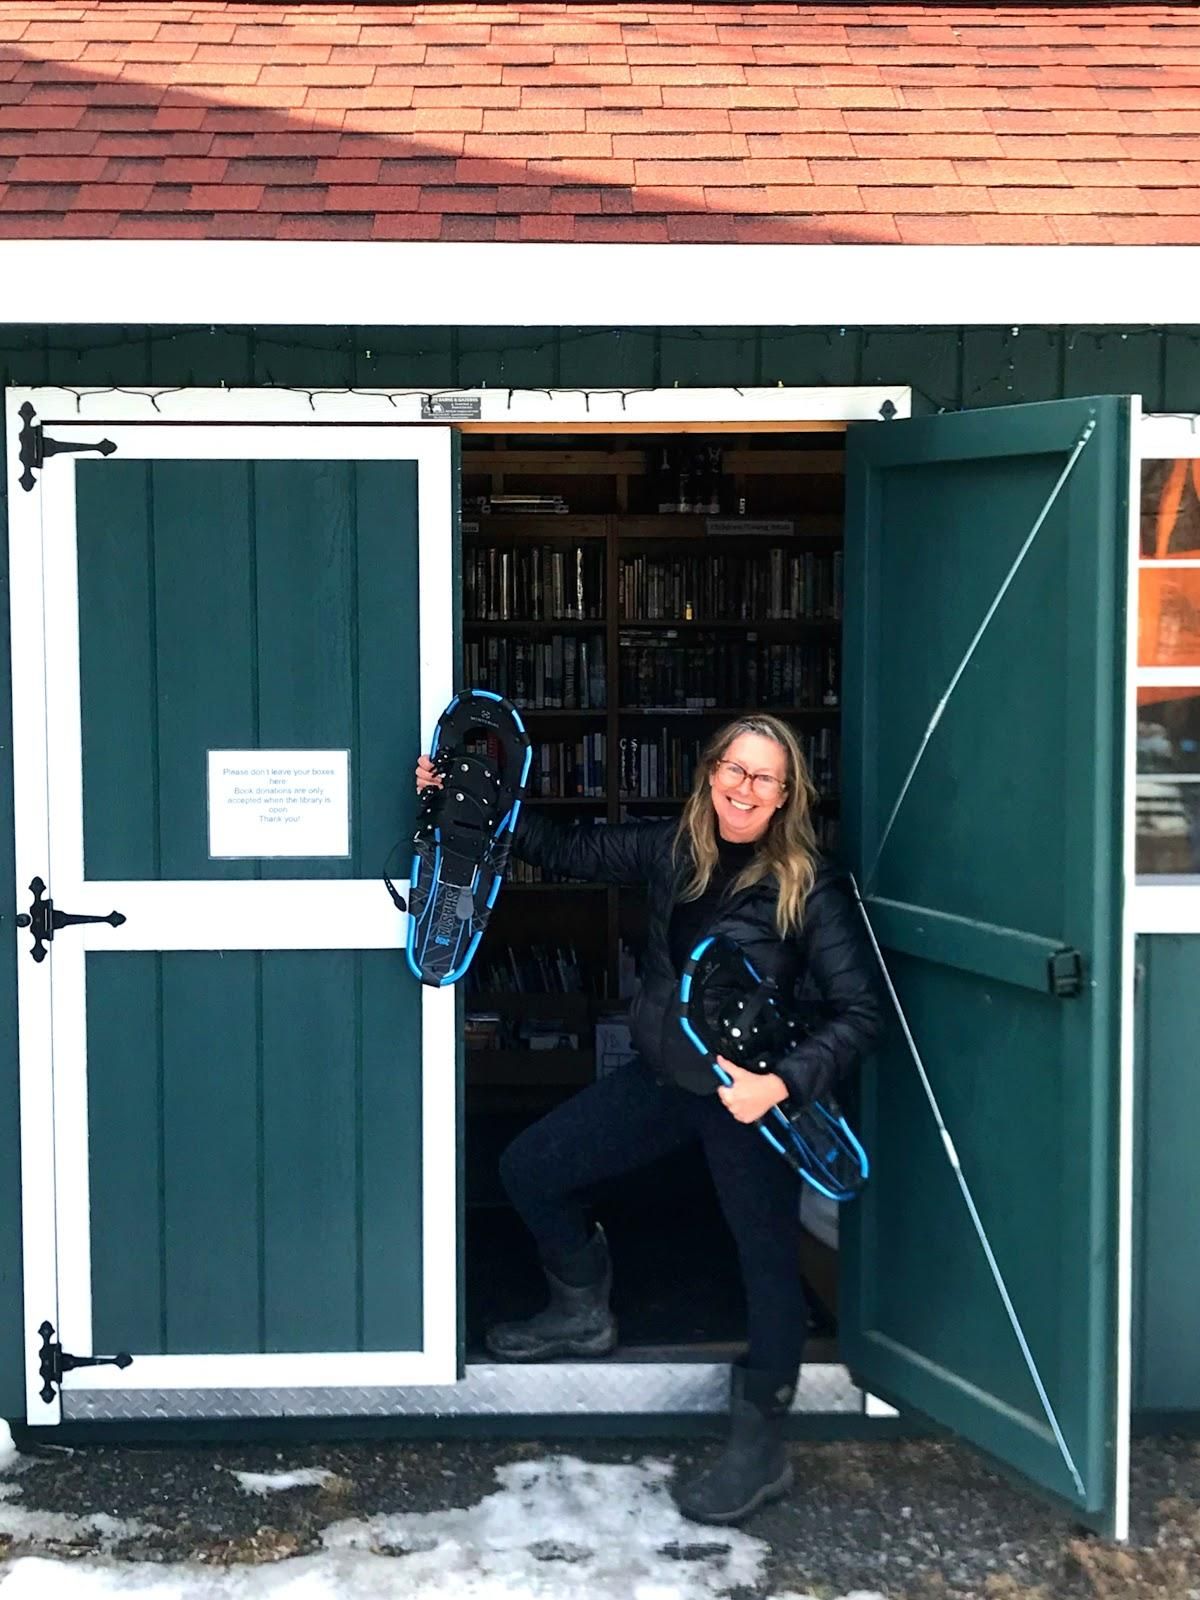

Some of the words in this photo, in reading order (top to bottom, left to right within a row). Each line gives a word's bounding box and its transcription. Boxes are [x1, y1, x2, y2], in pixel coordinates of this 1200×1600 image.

[223, 768, 249, 776] Please
[271, 768, 291, 776] leave
[293, 769, 311, 777] your
[312, 768, 335, 776] boxes
[234, 787, 253, 795] Book
[255, 786, 292, 795] donations
[308, 786, 324, 796] only
[227, 797, 261, 805] accepted
[263, 797, 284, 805] when
[285, 797, 298, 805] the
[299, 797, 323, 806] library
[324, 797, 331, 805] is
[259, 815, 282, 825] Thank
[283, 816, 301, 825] you!
